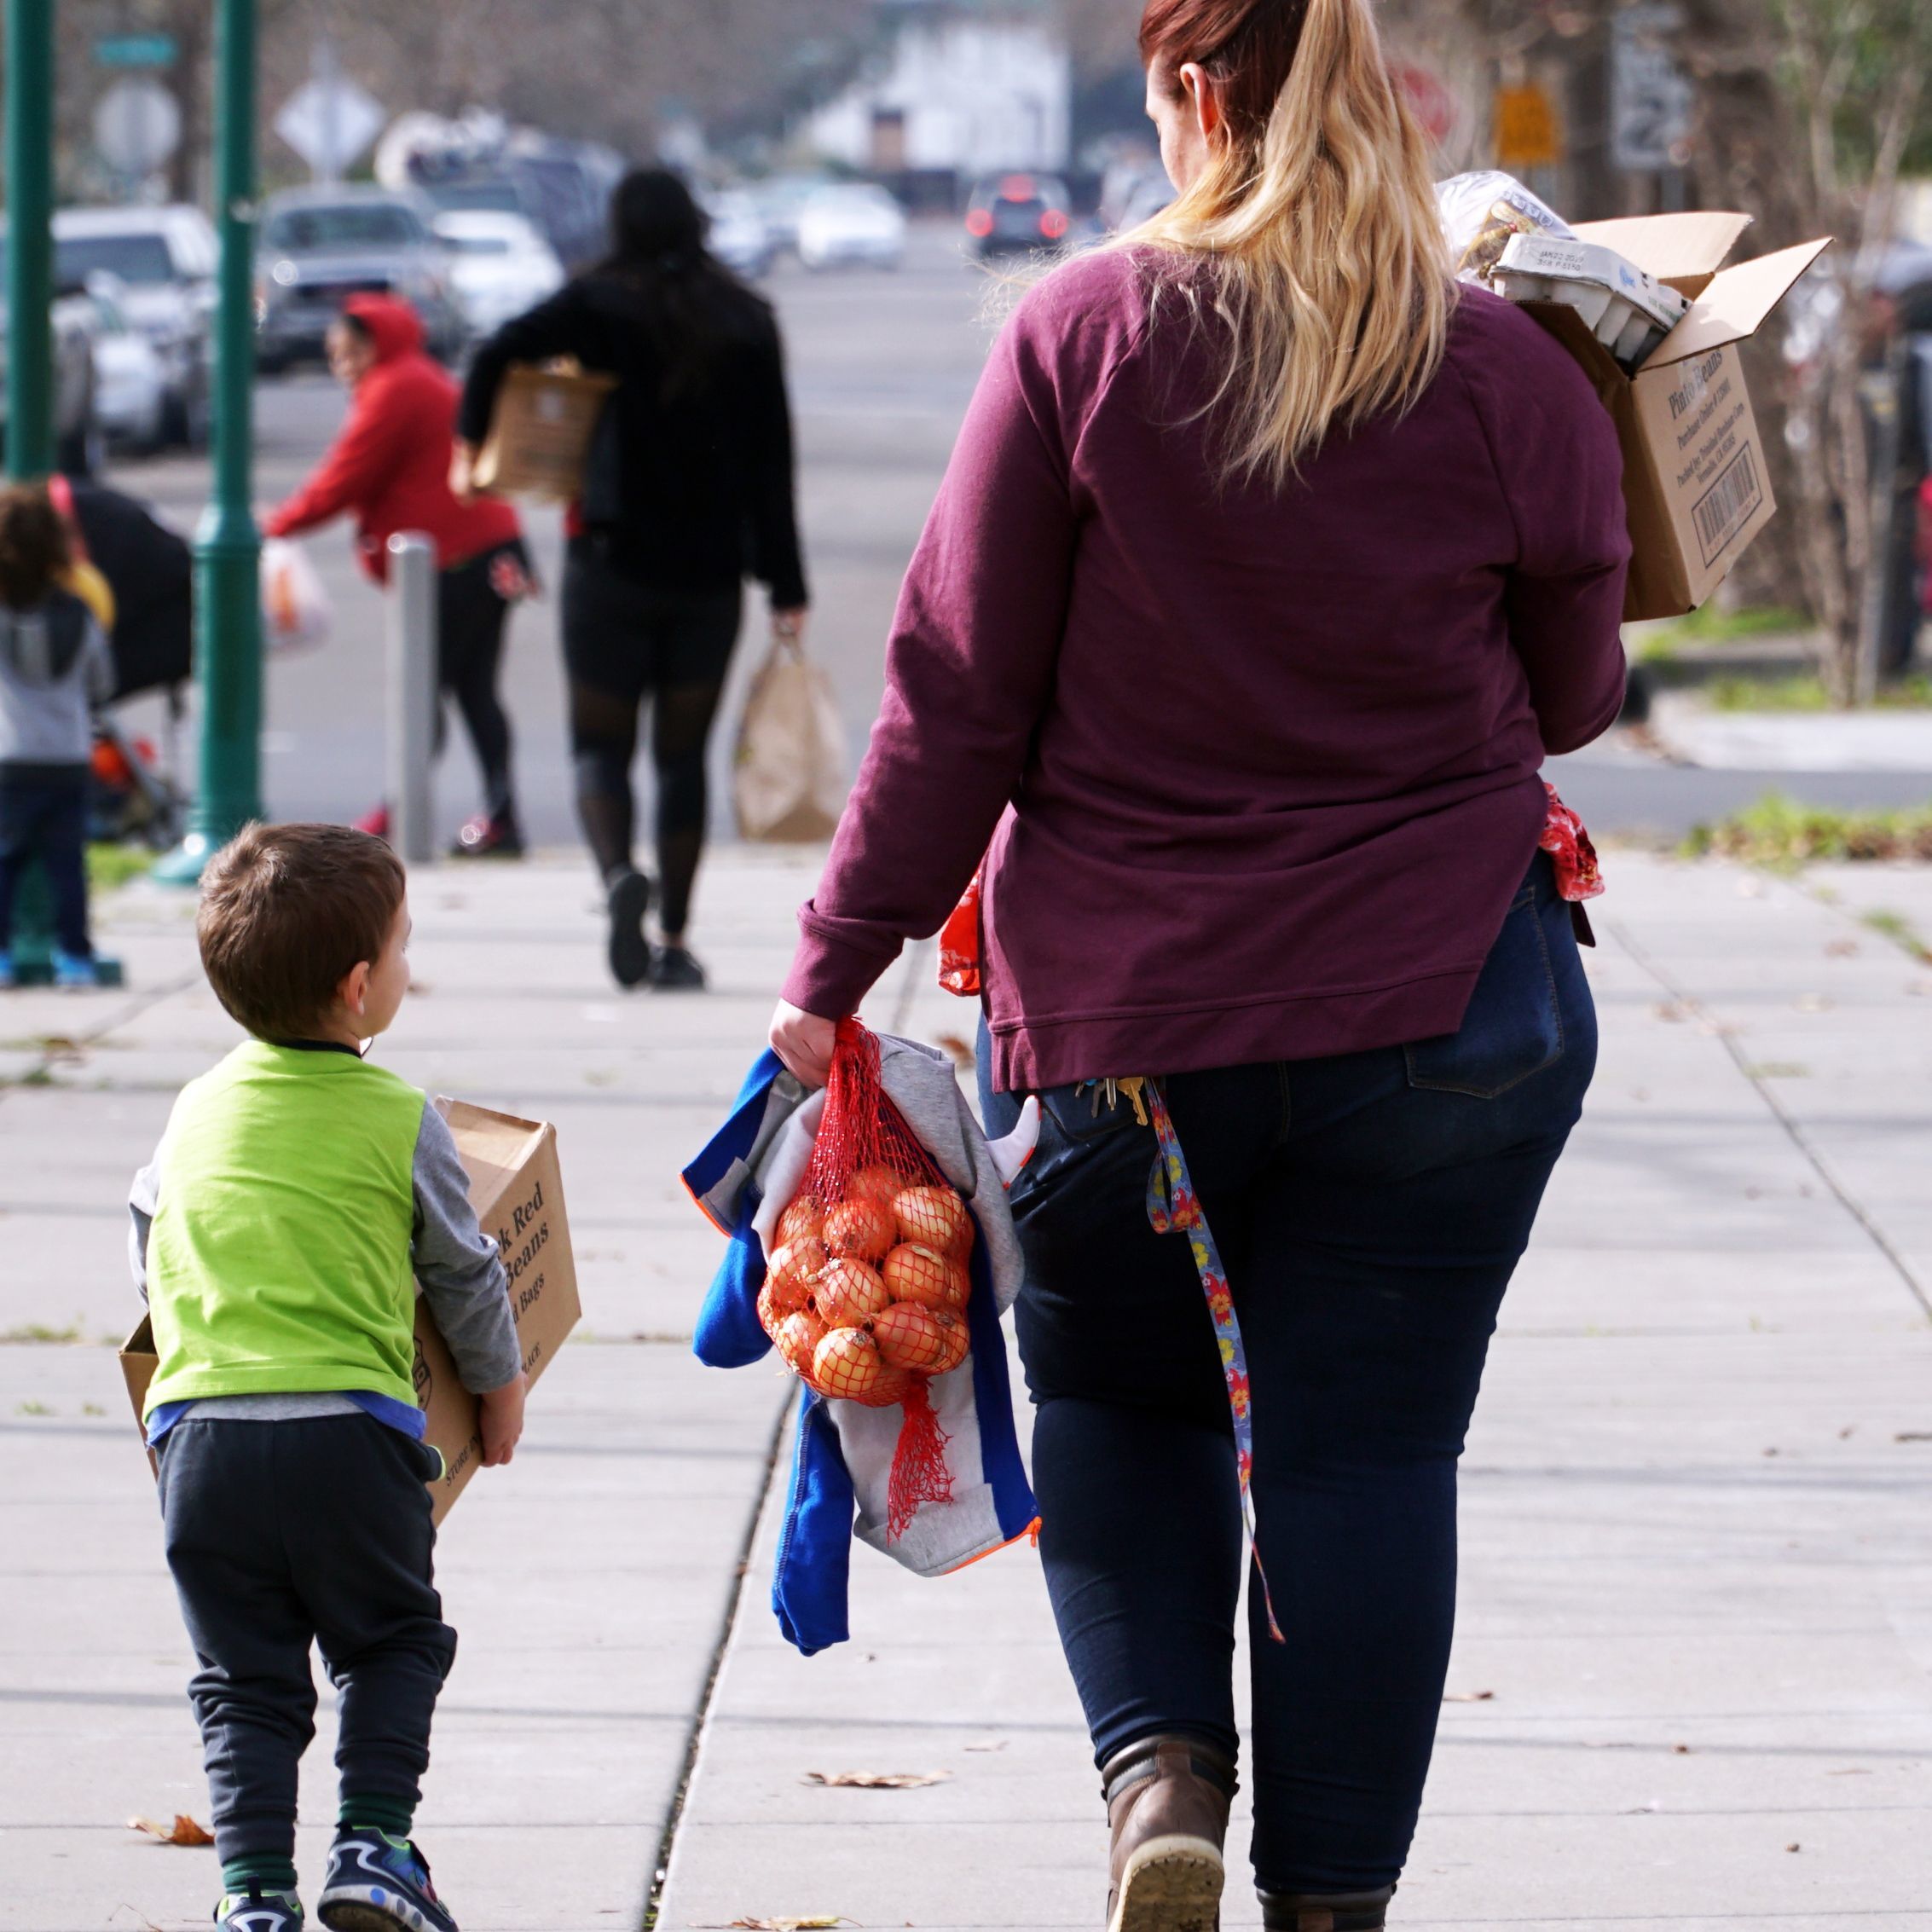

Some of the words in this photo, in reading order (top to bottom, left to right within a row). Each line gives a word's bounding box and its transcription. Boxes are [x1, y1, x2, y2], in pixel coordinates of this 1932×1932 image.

[1692, 350, 1722, 390] Beans
[512, 1180, 544, 1238] Red
[520, 1272, 544, 1313] Bags
